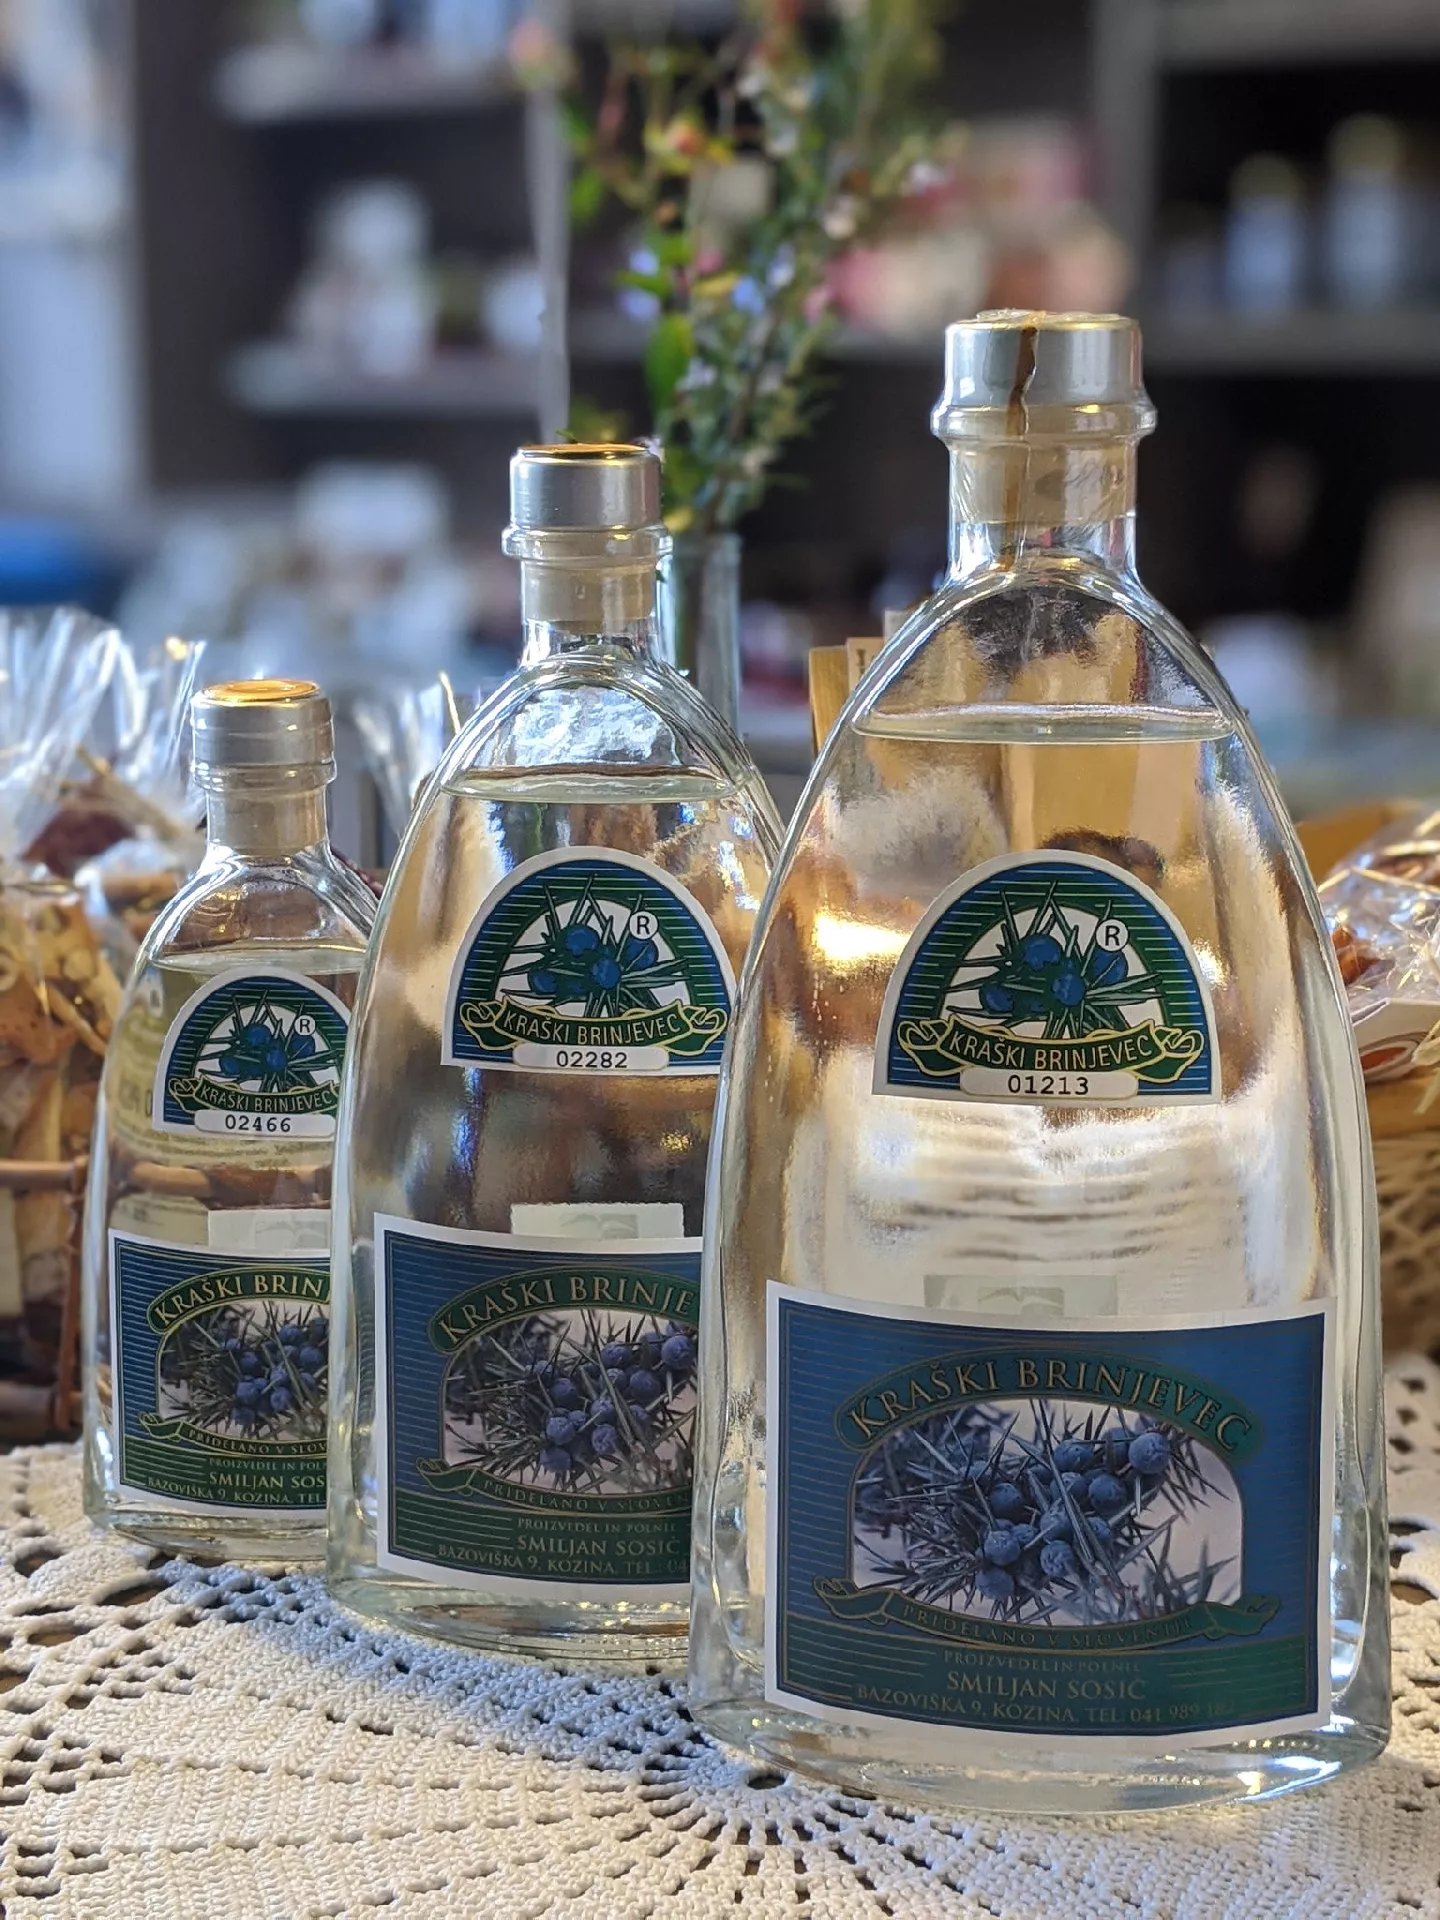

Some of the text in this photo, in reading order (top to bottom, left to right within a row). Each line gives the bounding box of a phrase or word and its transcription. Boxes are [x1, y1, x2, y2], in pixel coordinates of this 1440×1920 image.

[504, 1010, 681, 1045] KRAŠKI BRINJEVEC
[556, 1050, 628, 1069] 02282
[949, 1030, 1153, 1071] KRAŠKI BRINJEVEC
[1007, 1074, 1090, 1096] 01213
[200, 1086, 332, 1112] KRAŠKI BRINJEVEC
[225, 1114, 291, 1133] 02466
[155, 1275, 330, 1325] KRAŠKI BRIN
[438, 1276, 694, 1344] KRAŠKI BRINJE
[849, 1358, 1252, 1450] KRAŠKI BRINJEVEC
[188, 1429, 269, 1454] PRIDELANO
[209, 1471, 325, 1490] SMILJAN SOS
[484, 1480, 588, 1511] PRIDELANO
[438, 1544, 523, 1568] BAZOVIŠKA
[517, 1535, 606, 1557] SMILJAN
[902, 1604, 1035, 1645] PRIDELANO
[1048, 1633, 1060, 1646] V
[947, 1671, 1057, 1700] SMILJAN
